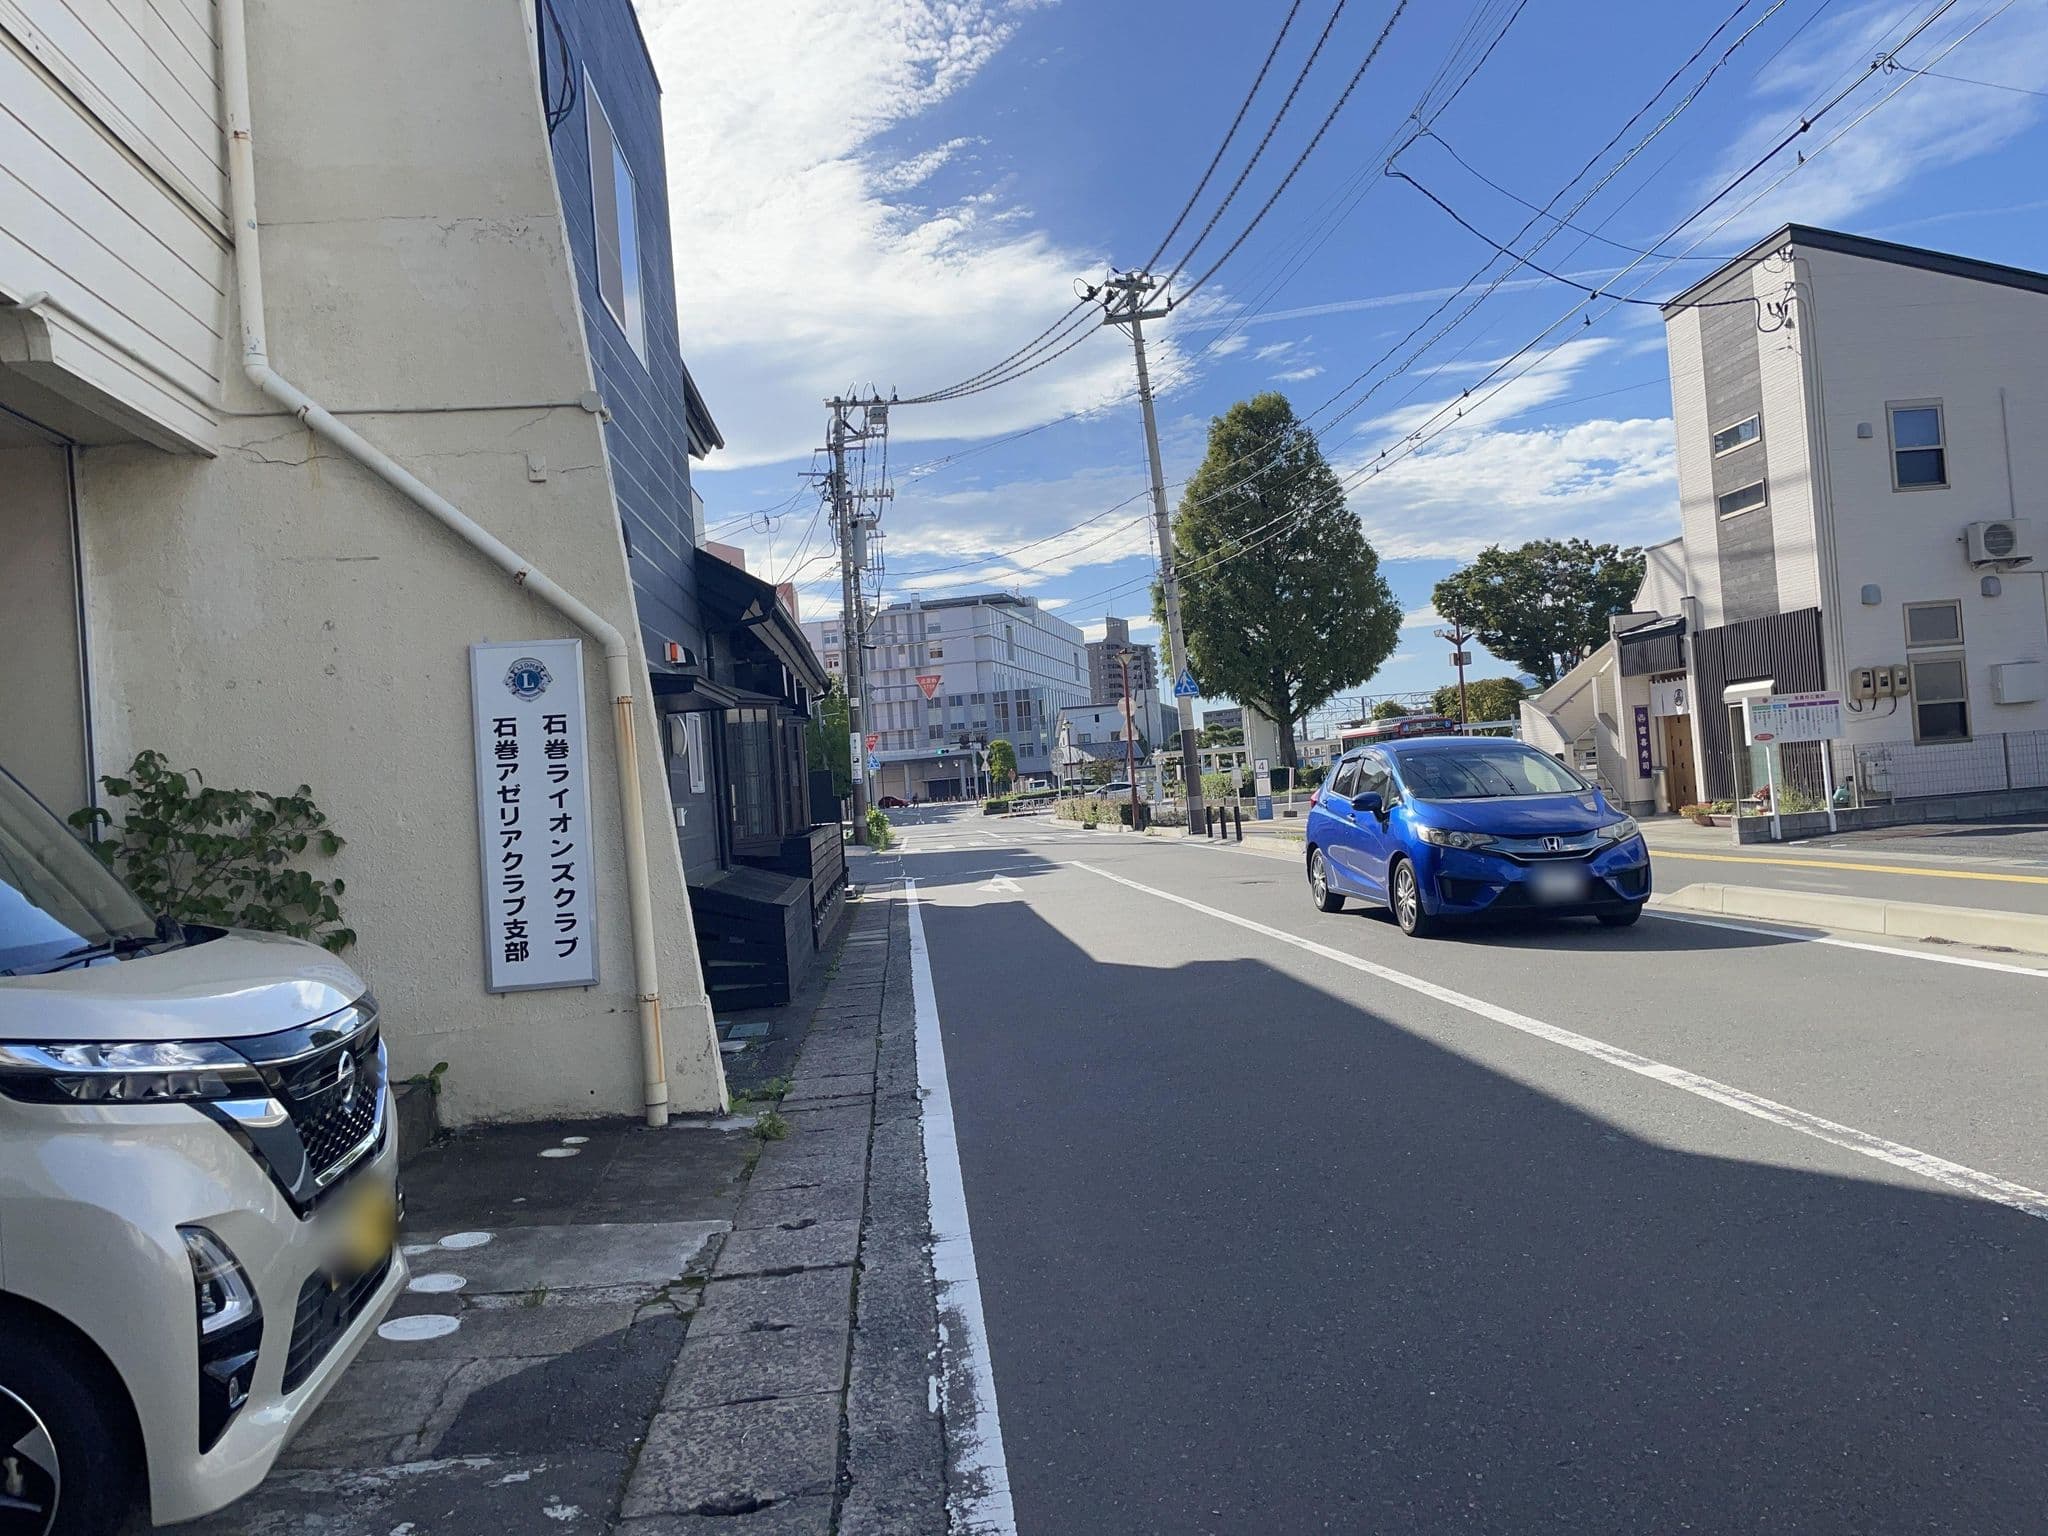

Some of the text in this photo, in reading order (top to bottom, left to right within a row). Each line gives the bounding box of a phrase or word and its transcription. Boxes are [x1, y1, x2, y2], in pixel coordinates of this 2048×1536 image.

[493, 717, 530, 963] 石巻アゼリアクラブ支部
[542, 714, 579, 958] 石巻ライオンズクラブ
[1258, 761, 1264, 770] 4
